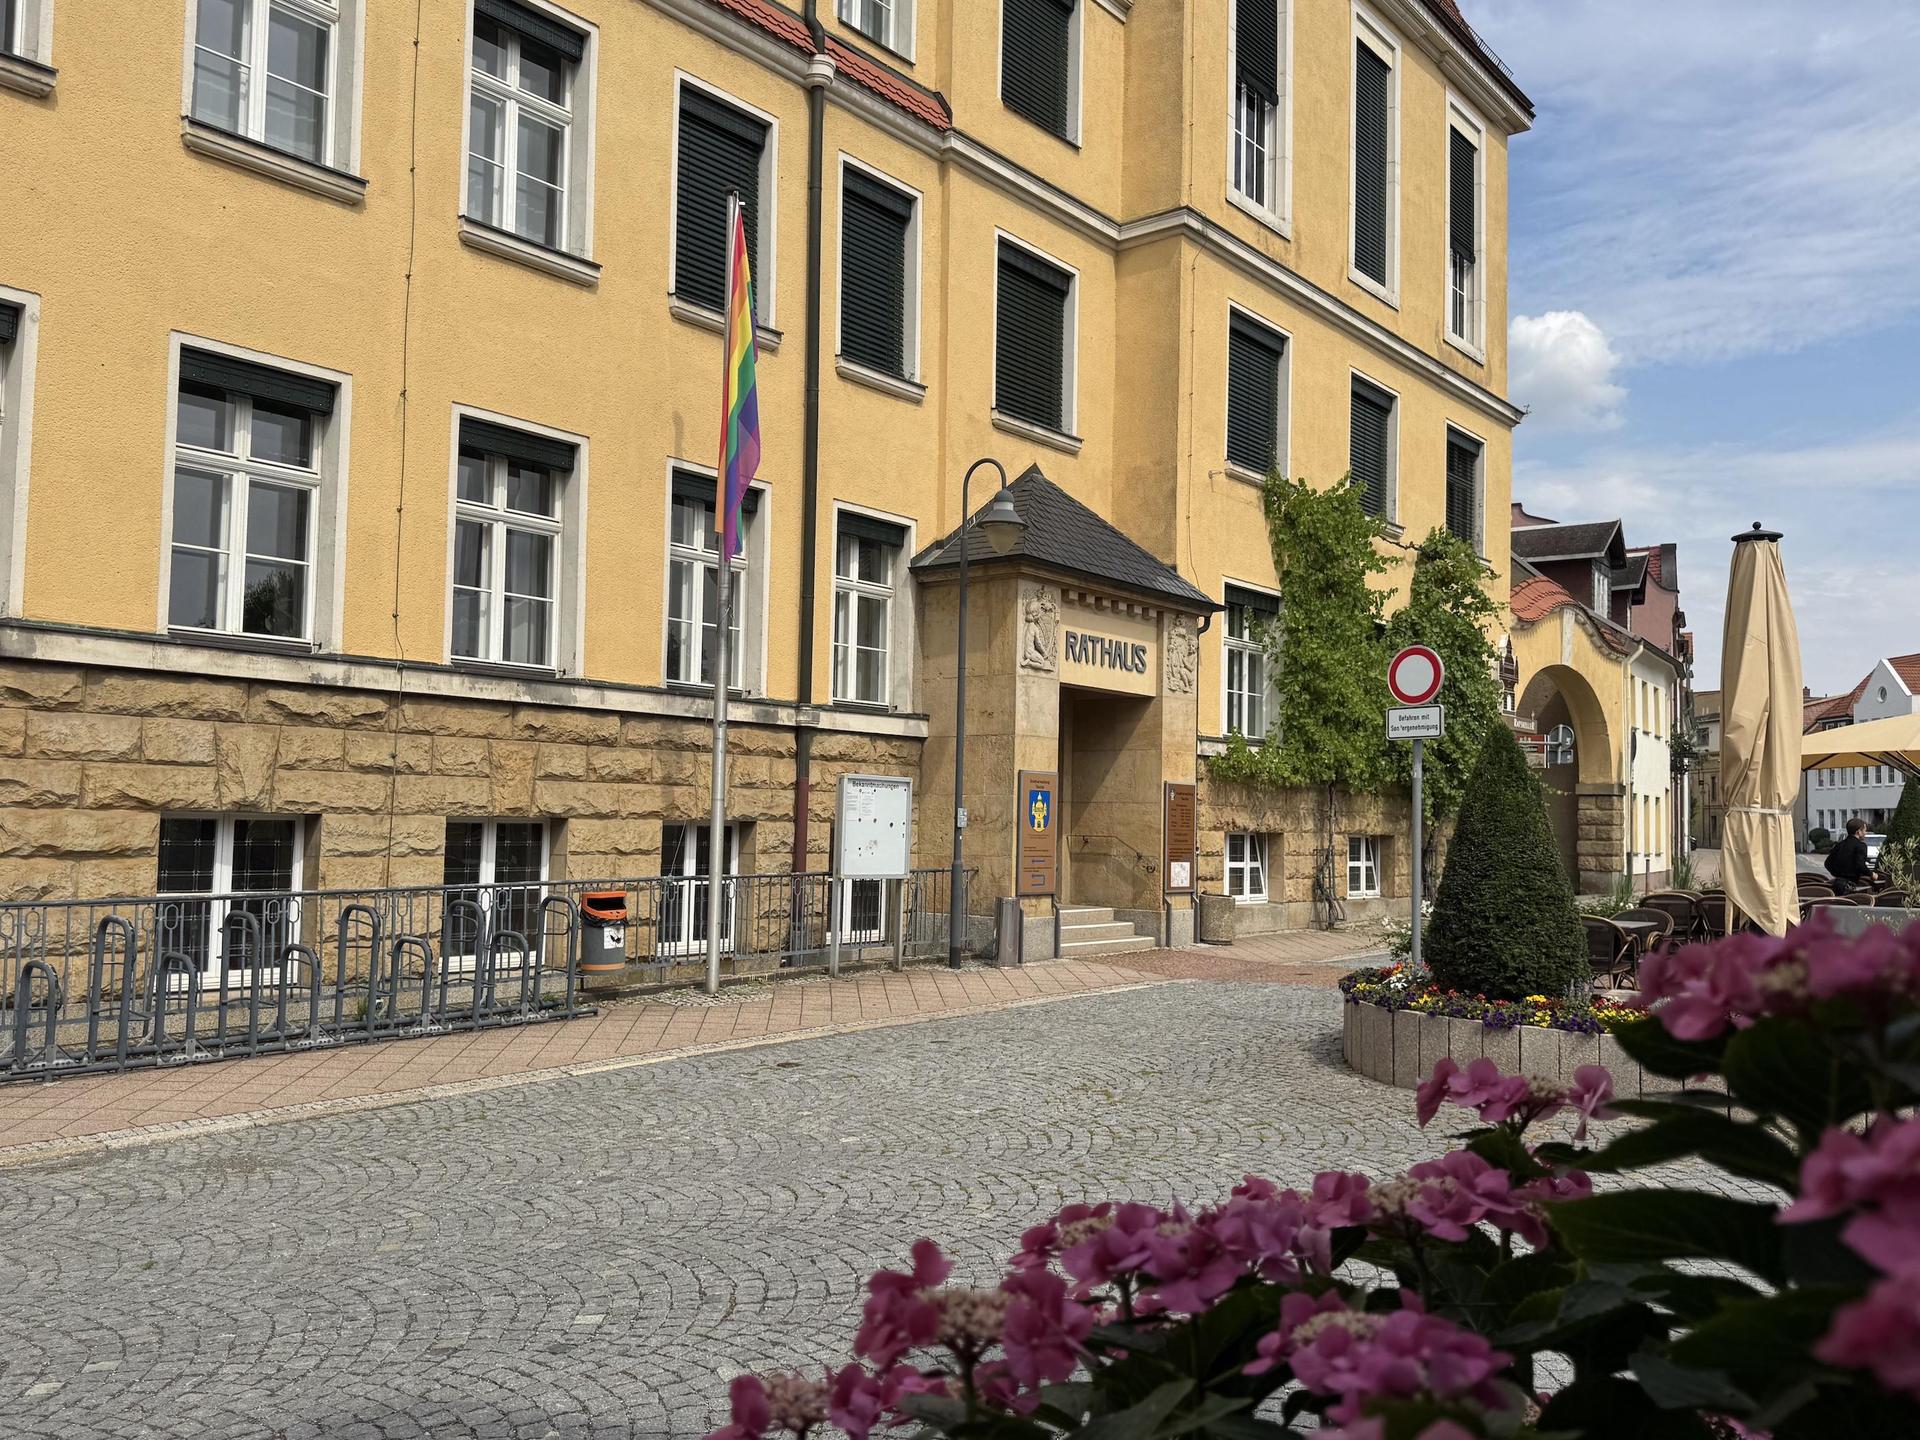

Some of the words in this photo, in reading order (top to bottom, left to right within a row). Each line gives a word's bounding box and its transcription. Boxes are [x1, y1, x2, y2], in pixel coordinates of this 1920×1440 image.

[1065, 630, 1147, 674] RATHAUS
[1399, 714, 1420, 722] Befahren
[852, 780, 900, 790] Bekanntmachungen
